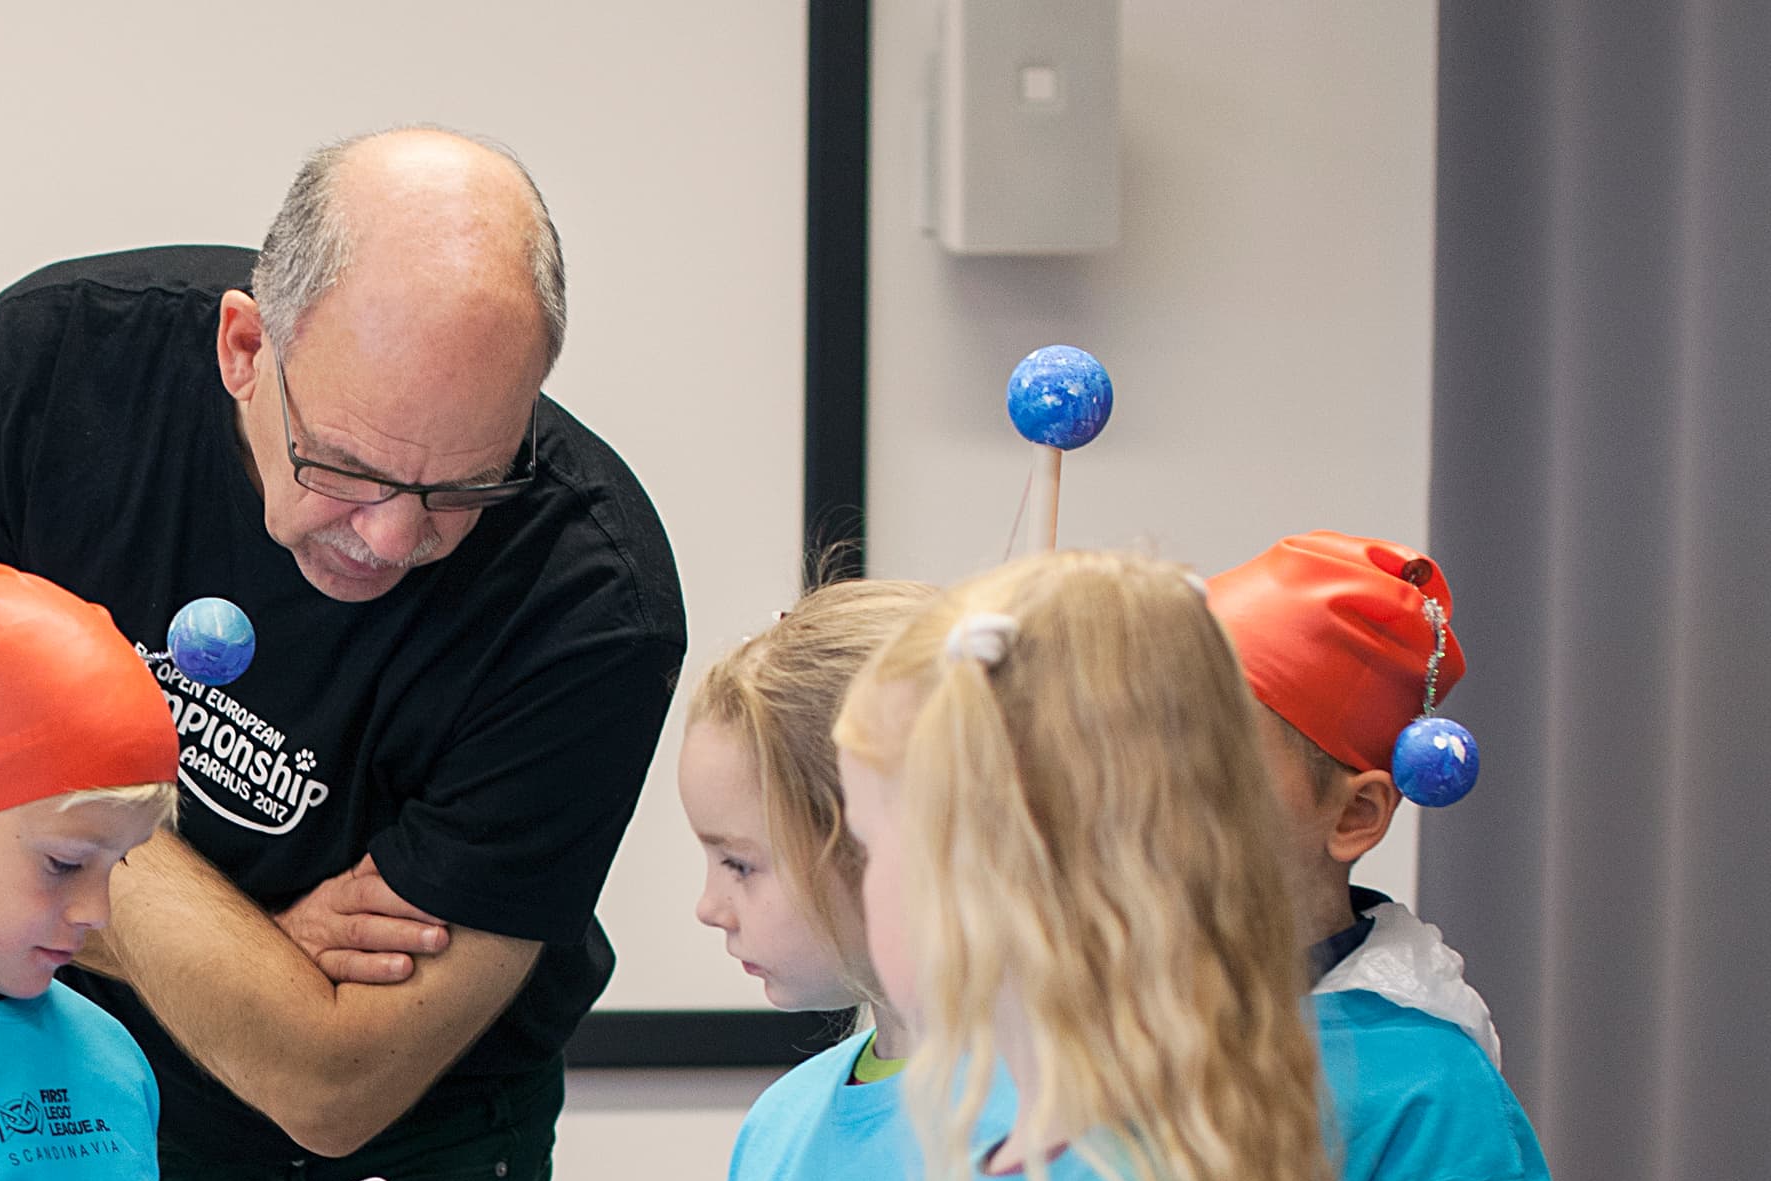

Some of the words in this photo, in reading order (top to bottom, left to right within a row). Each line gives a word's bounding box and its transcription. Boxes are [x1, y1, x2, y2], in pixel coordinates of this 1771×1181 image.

[156, 663, 206, 699] OPEN
[206, 688, 286, 750] EUROPEAN
[179, 745, 252, 801] AARHUS
[253, 791, 289, 823] 2017
[9, 1139, 121, 1167] SCANDINAVIA
[49, 1121, 94, 1137] LEAGUE
